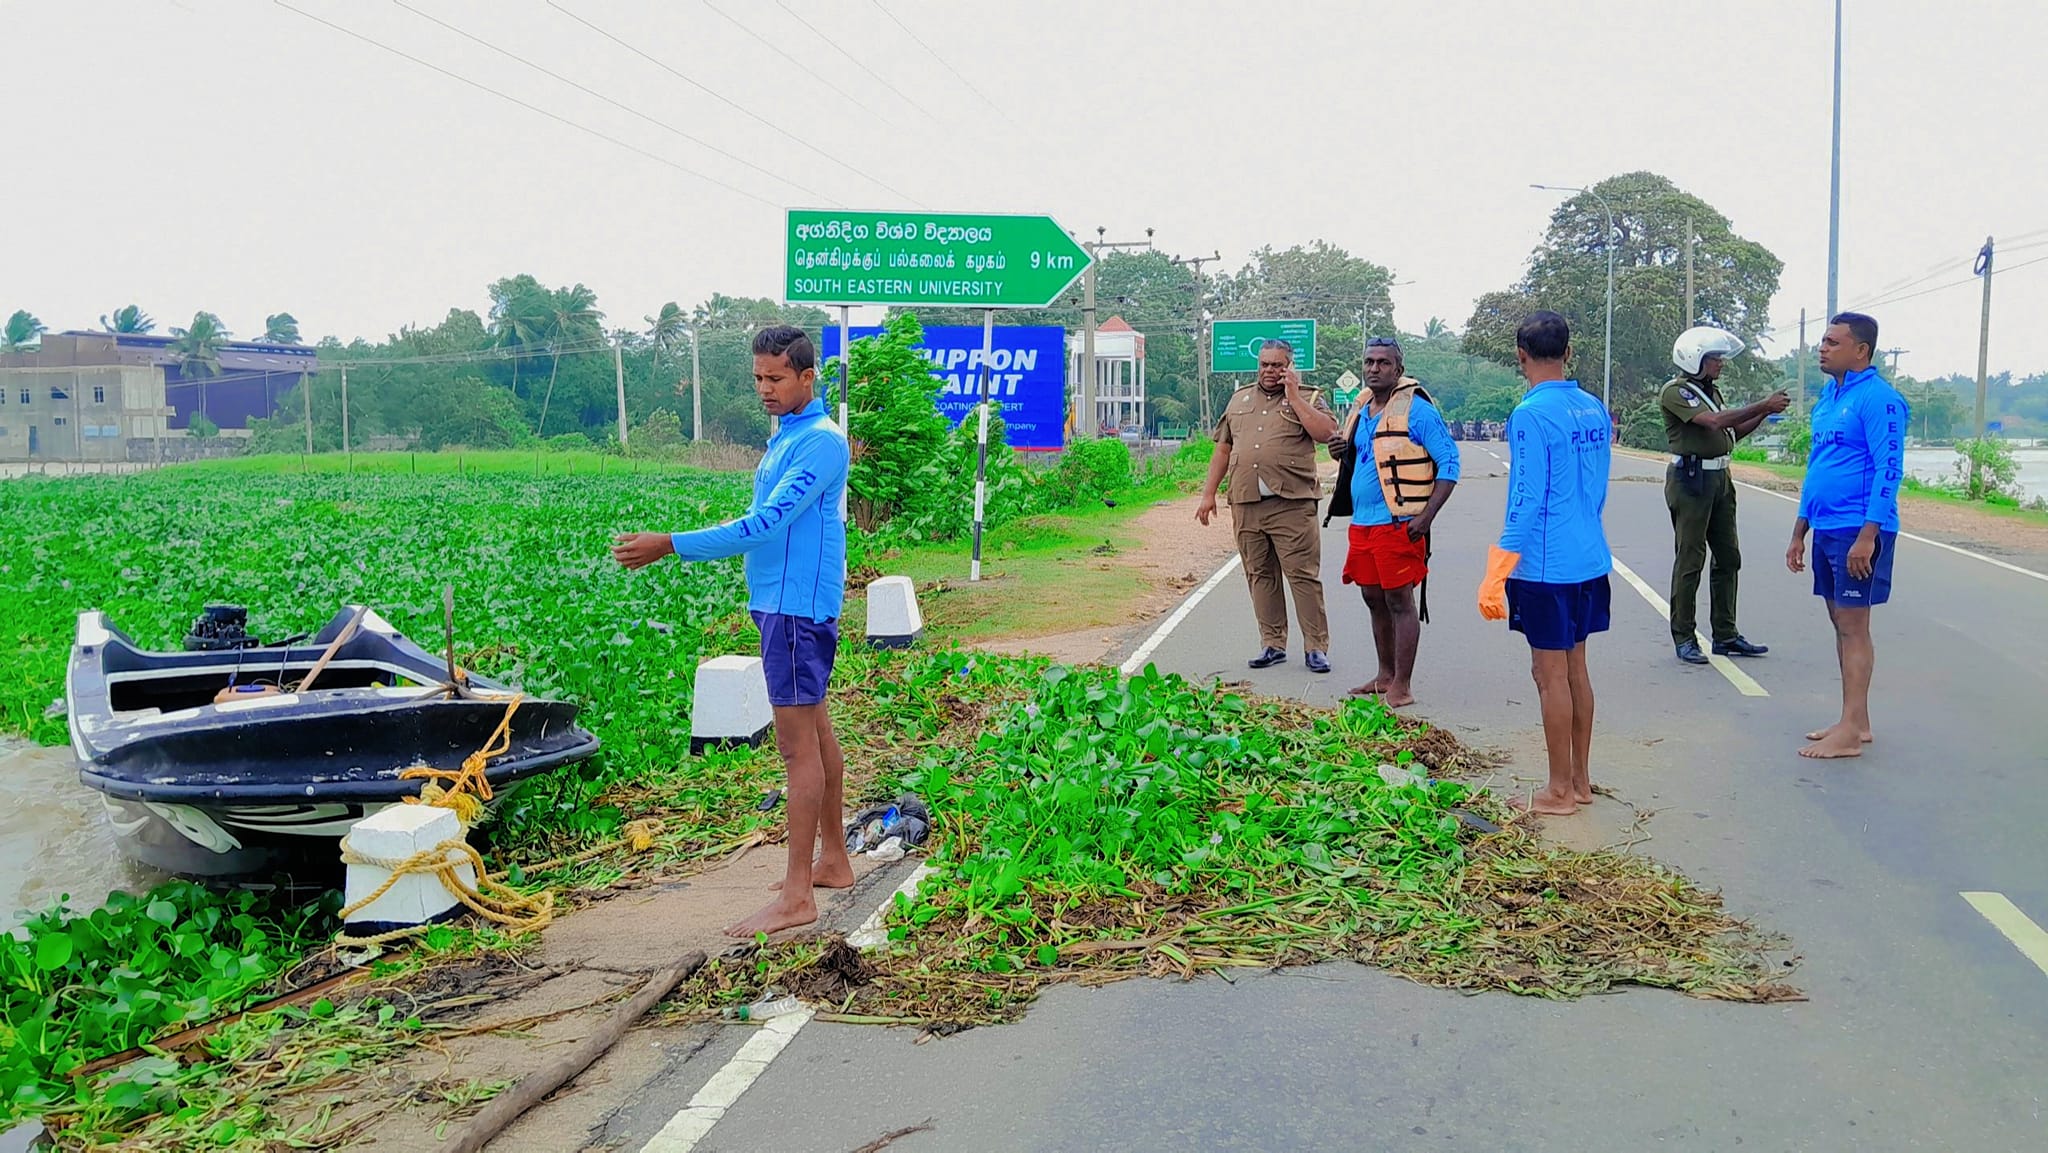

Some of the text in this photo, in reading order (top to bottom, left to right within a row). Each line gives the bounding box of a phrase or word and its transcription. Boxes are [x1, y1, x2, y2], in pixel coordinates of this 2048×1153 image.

[889, 248, 955, 268] பல்கலைக்
[965, 250, 1006, 273] கழகம்
[1030, 251, 1073, 269] 9 km
[794, 278, 1003, 296] SOUTH EASTERN UNIVERSITY
[1880, 403, 1898, 499] RESCUE
[1509, 430, 1527, 523] RESCUE
[736, 469, 816, 539] RESCUE
